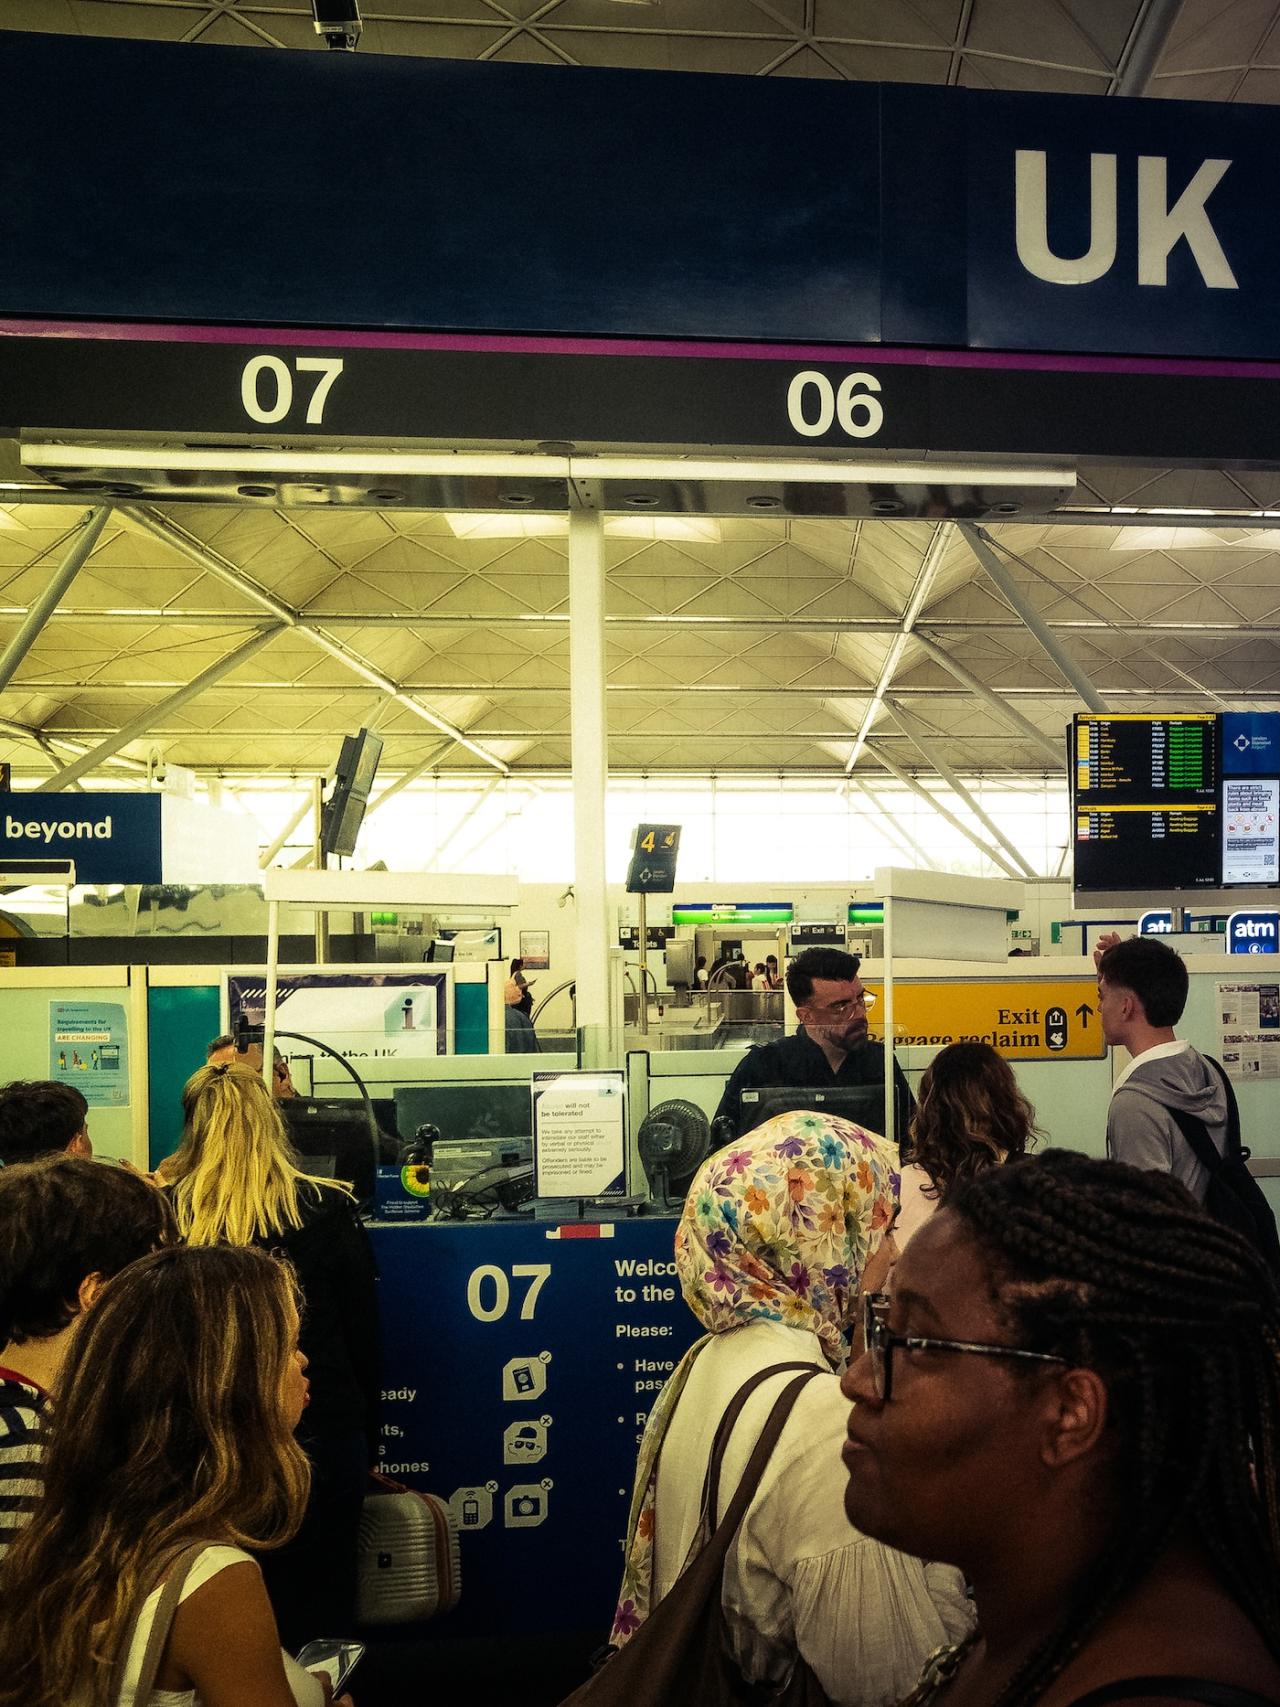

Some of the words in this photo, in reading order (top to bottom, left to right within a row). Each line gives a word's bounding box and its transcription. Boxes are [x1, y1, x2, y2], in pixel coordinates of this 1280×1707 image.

[1014, 149, 1240, 289] UK
[241, 354, 345, 425] 07
[786, 370, 884, 439] 06
[6, 815, 112, 843] beyond
[641, 831, 655, 853] 4
[1234, 919, 1275, 938] atm
[633, 940, 658, 948] Toets
[998, 1008, 1041, 1025] Exit
[866, 1033, 953, 1046] Bggage
[960, 1031, 1042, 1049] reclaim
[614, 1259, 678, 1277] Welco
[467, 1262, 552, 1322] 07
[614, 1286, 637, 1303] to
[642, 1284, 676, 1302] the
[615, 1324, 674, 1338] Please:
[635, 1359, 676, 1373] Have
[380, 1386, 418, 1402] eady
